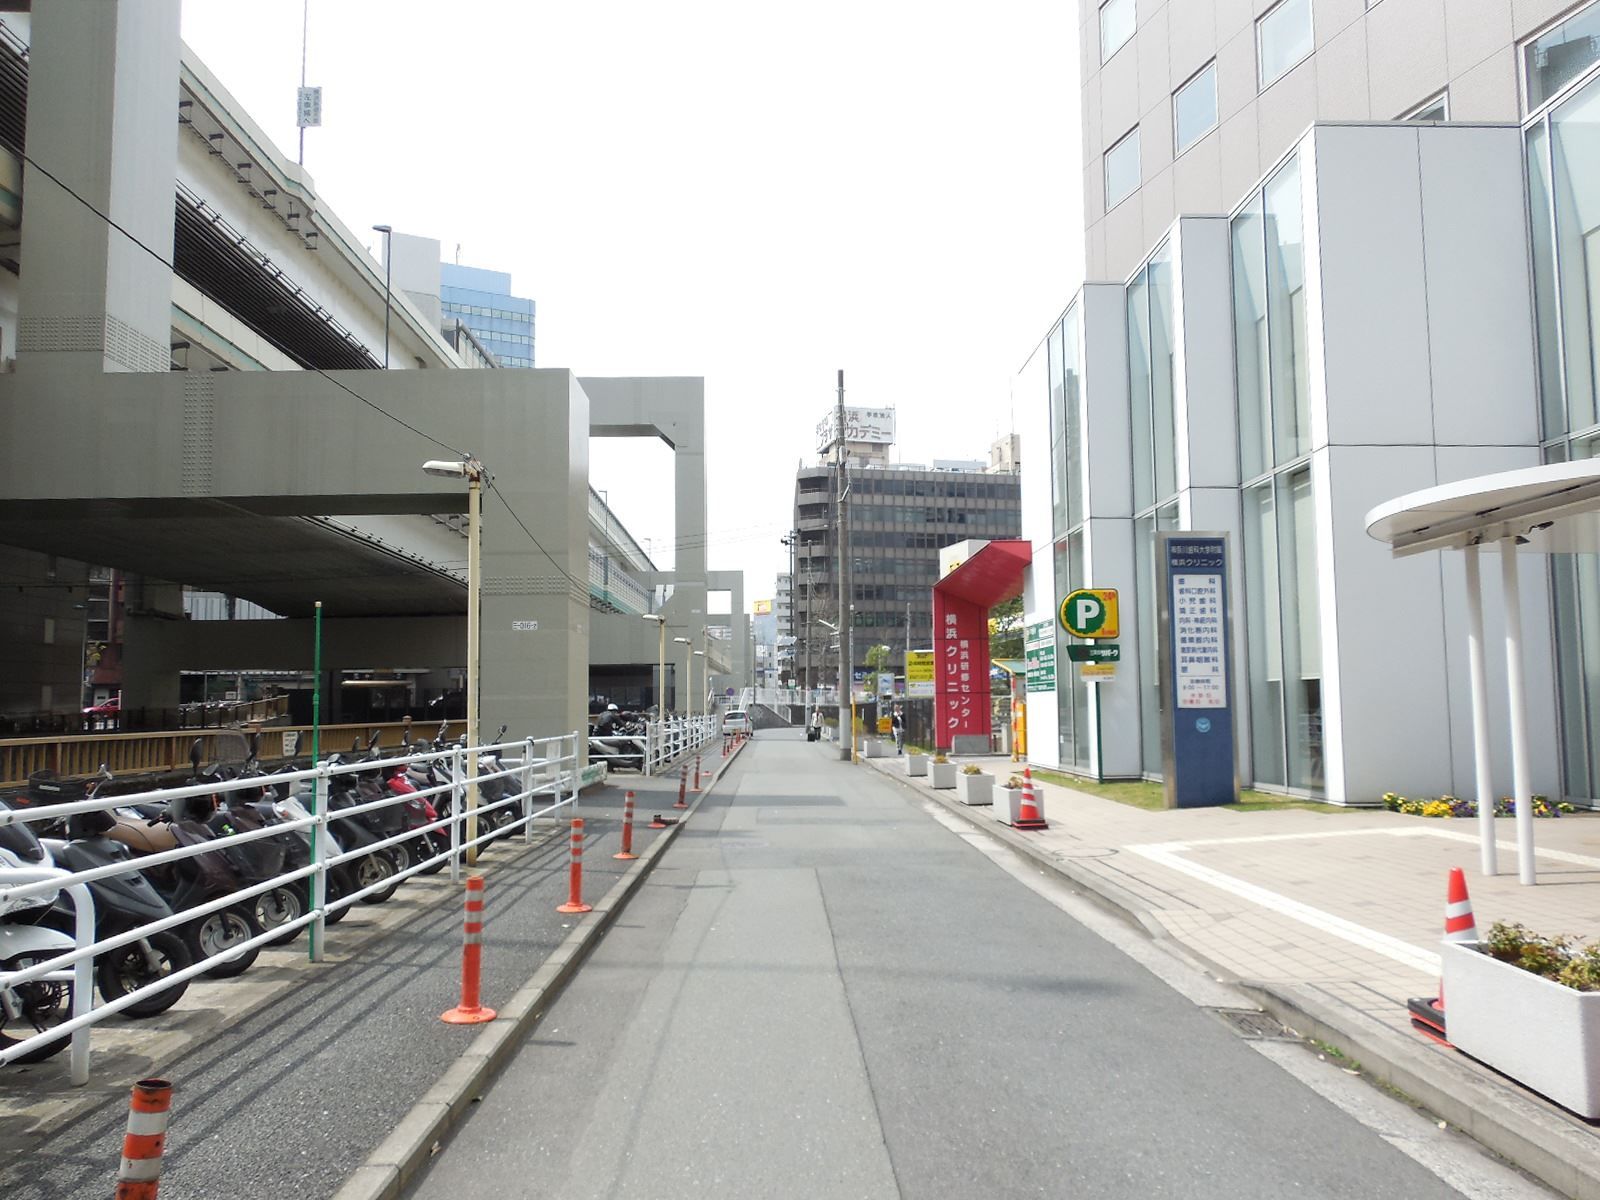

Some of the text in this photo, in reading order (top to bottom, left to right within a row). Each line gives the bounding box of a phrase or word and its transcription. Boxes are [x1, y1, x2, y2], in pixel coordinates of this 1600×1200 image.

[1171, 558, 1222, 568] 横浜クリニック
[1076, 599, 1100, 629] P
[945, 614, 960, 729] 横浜クリニック
